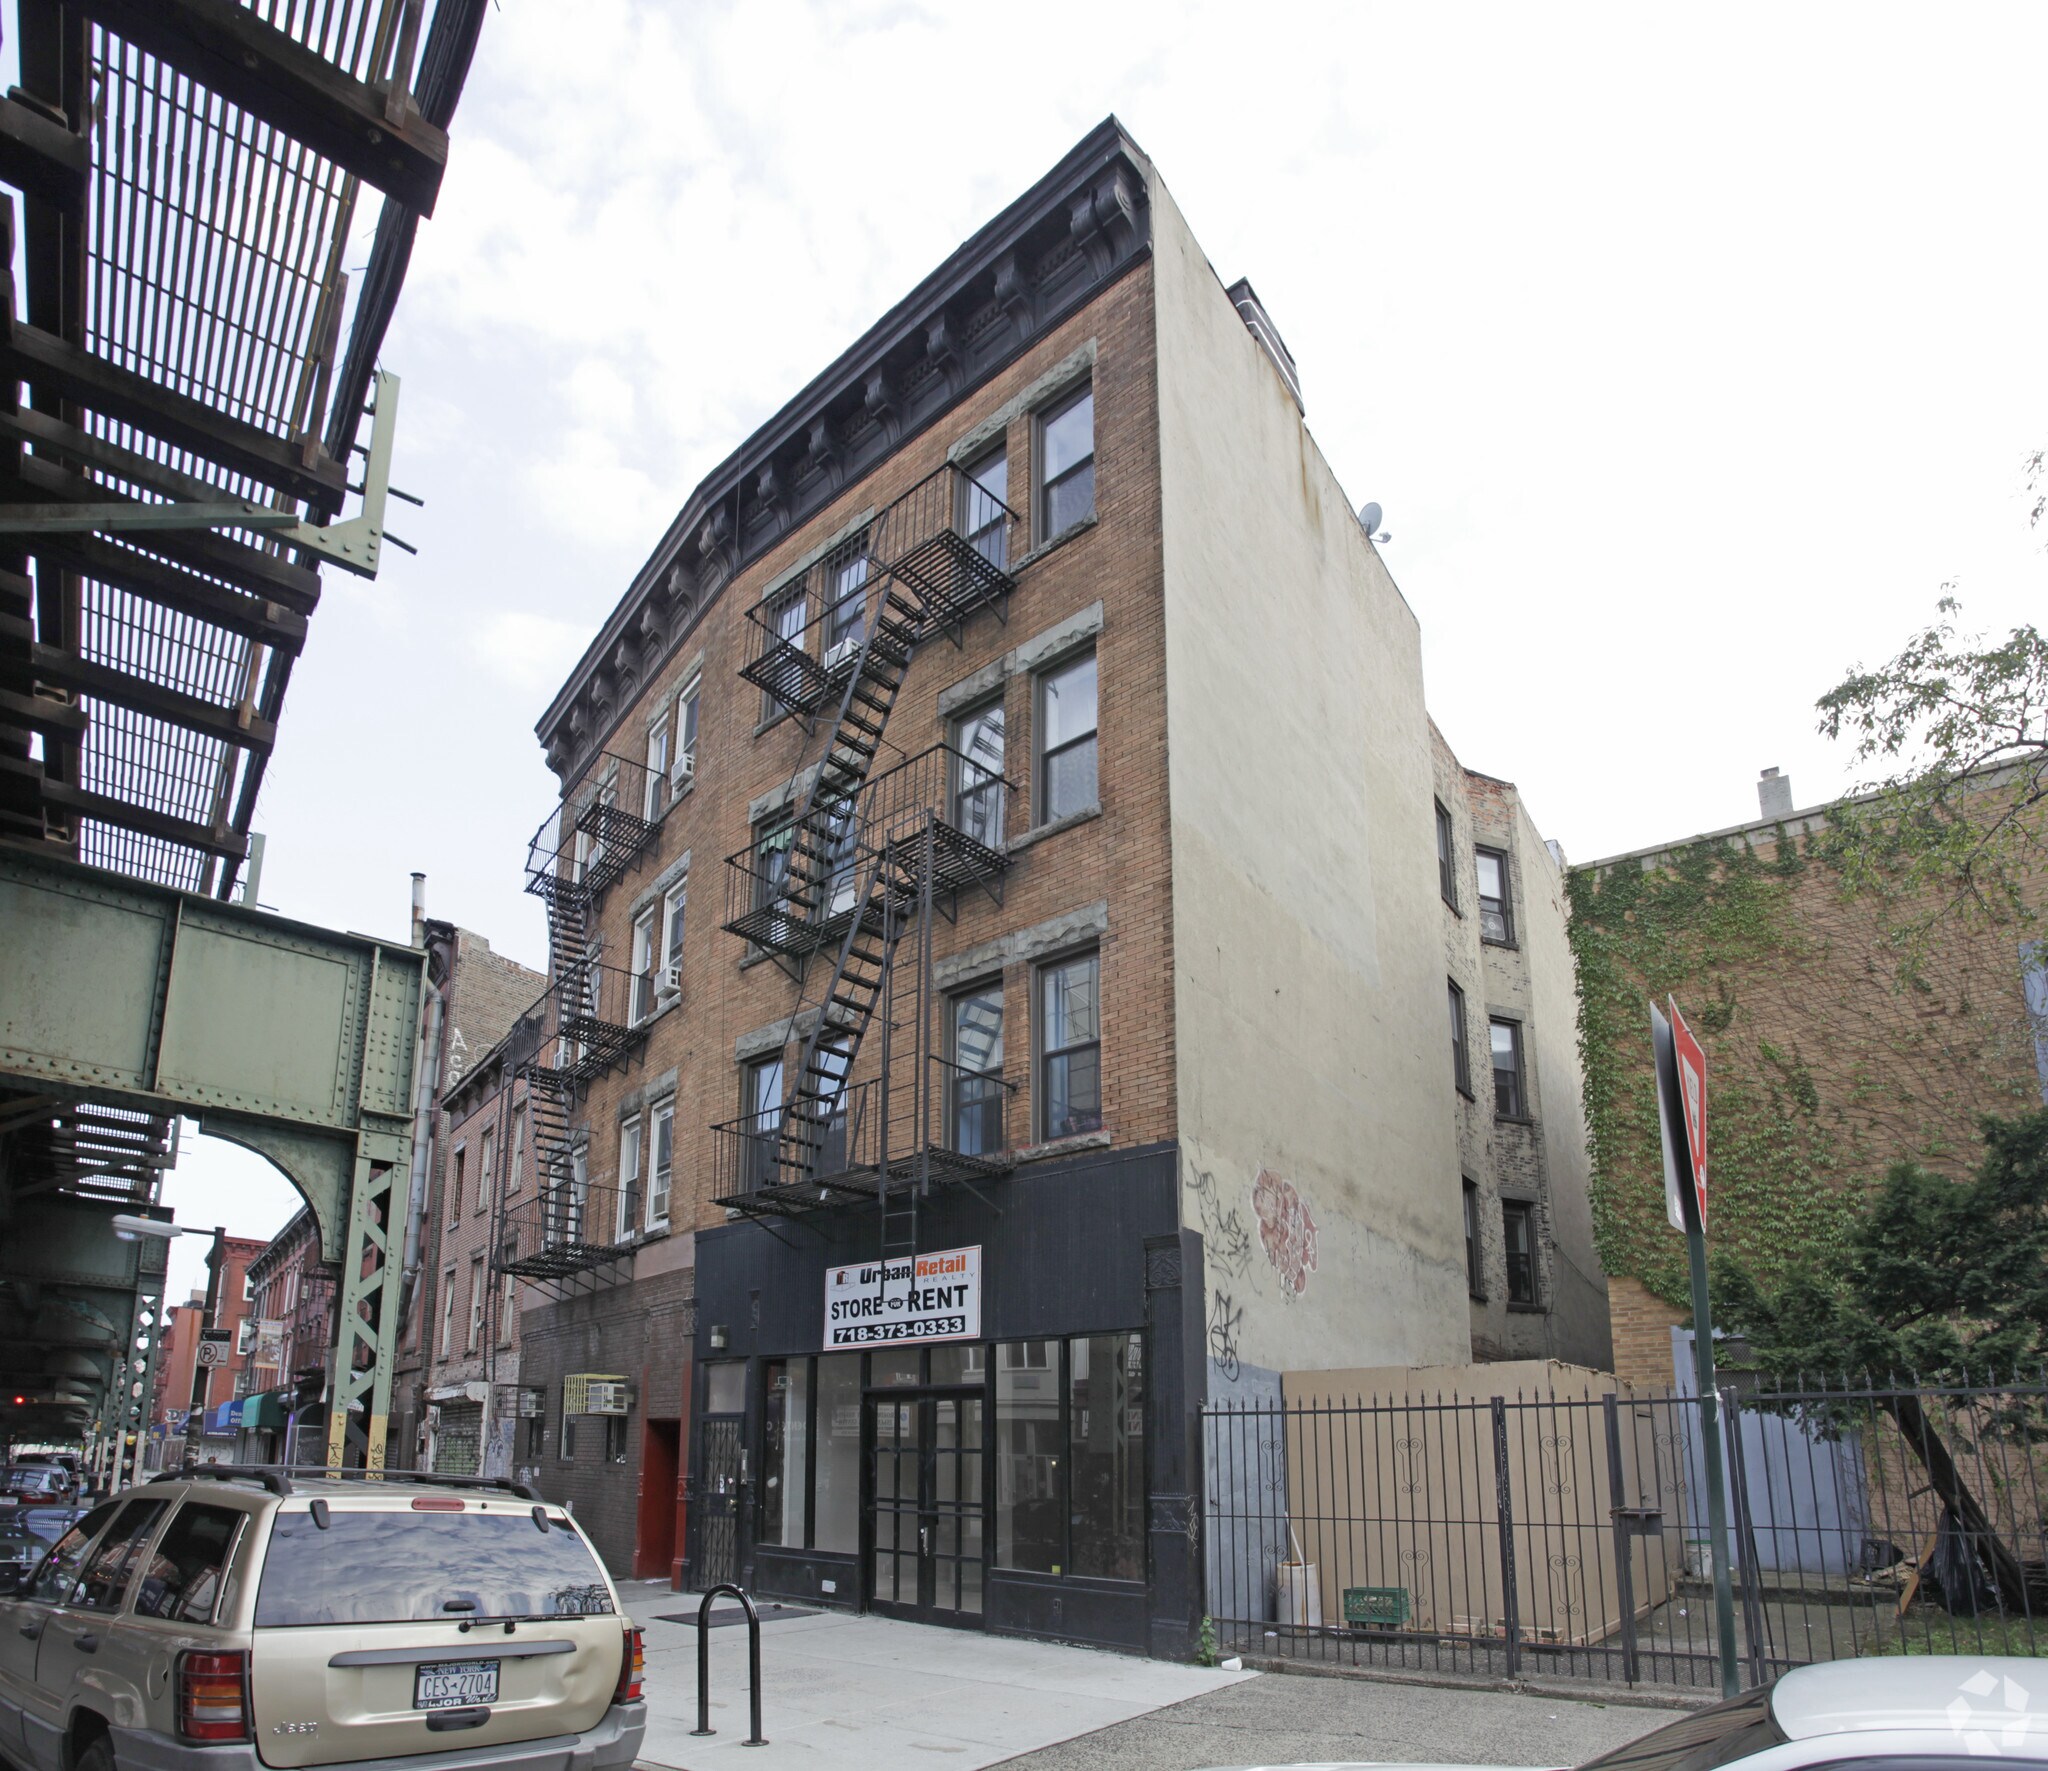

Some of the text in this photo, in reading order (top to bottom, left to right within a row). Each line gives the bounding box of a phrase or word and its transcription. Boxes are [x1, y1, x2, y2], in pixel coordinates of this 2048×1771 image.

[860, 1254, 966, 1285] Urban Retail
[923, 1272, 976, 1284] REALTY
[831, 1297, 883, 1320] STORE
[908, 1284, 969, 1312] RENT
[836, 1317, 963, 1343] 718-373-0333
[438, 1665, 480, 1675] NEW YORK
[272, 1720, 318, 1736] Jeep
